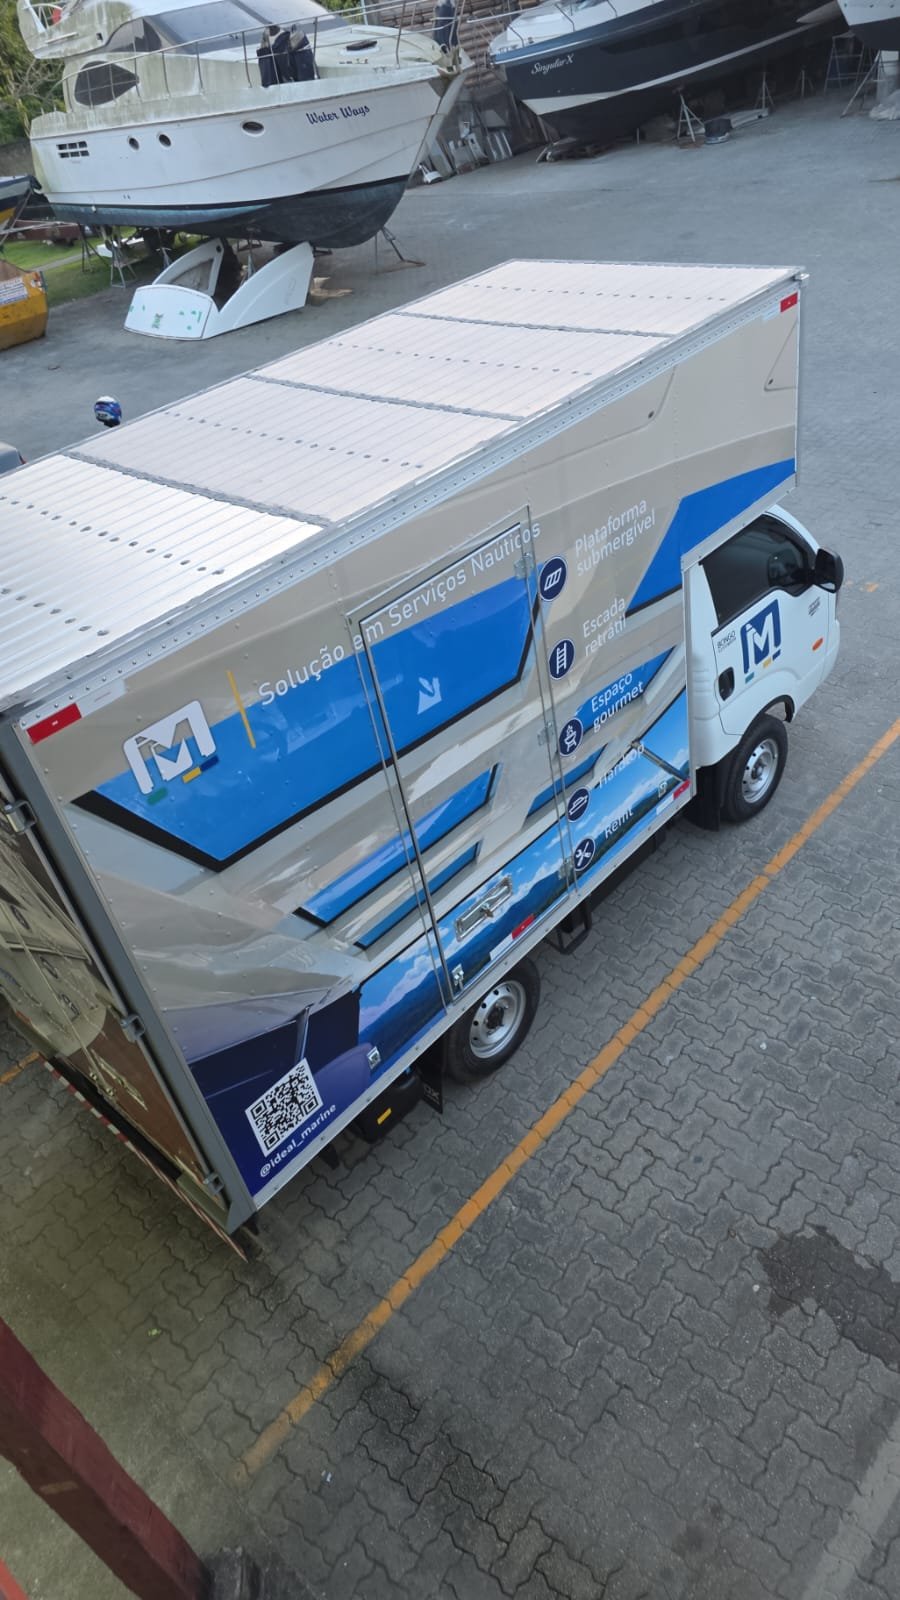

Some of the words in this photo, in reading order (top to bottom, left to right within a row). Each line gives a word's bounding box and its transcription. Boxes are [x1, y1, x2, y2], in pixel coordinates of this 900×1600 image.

[305, 111, 340, 125] Water
[339, 105, 371, 118] Ways
[575, 500, 647, 559] Plataforma
[577, 507, 656, 577] submergível
[258, 644, 346, 706] Solução
[352, 619, 385, 651] em
[388, 567, 467, 628] Serviços
[582, 597, 626, 639] Escada
[590, 672, 633, 713] Espaço
[592, 680, 645, 734] gourmet
[259, 1104, 336, 1178] @ideal_marine
